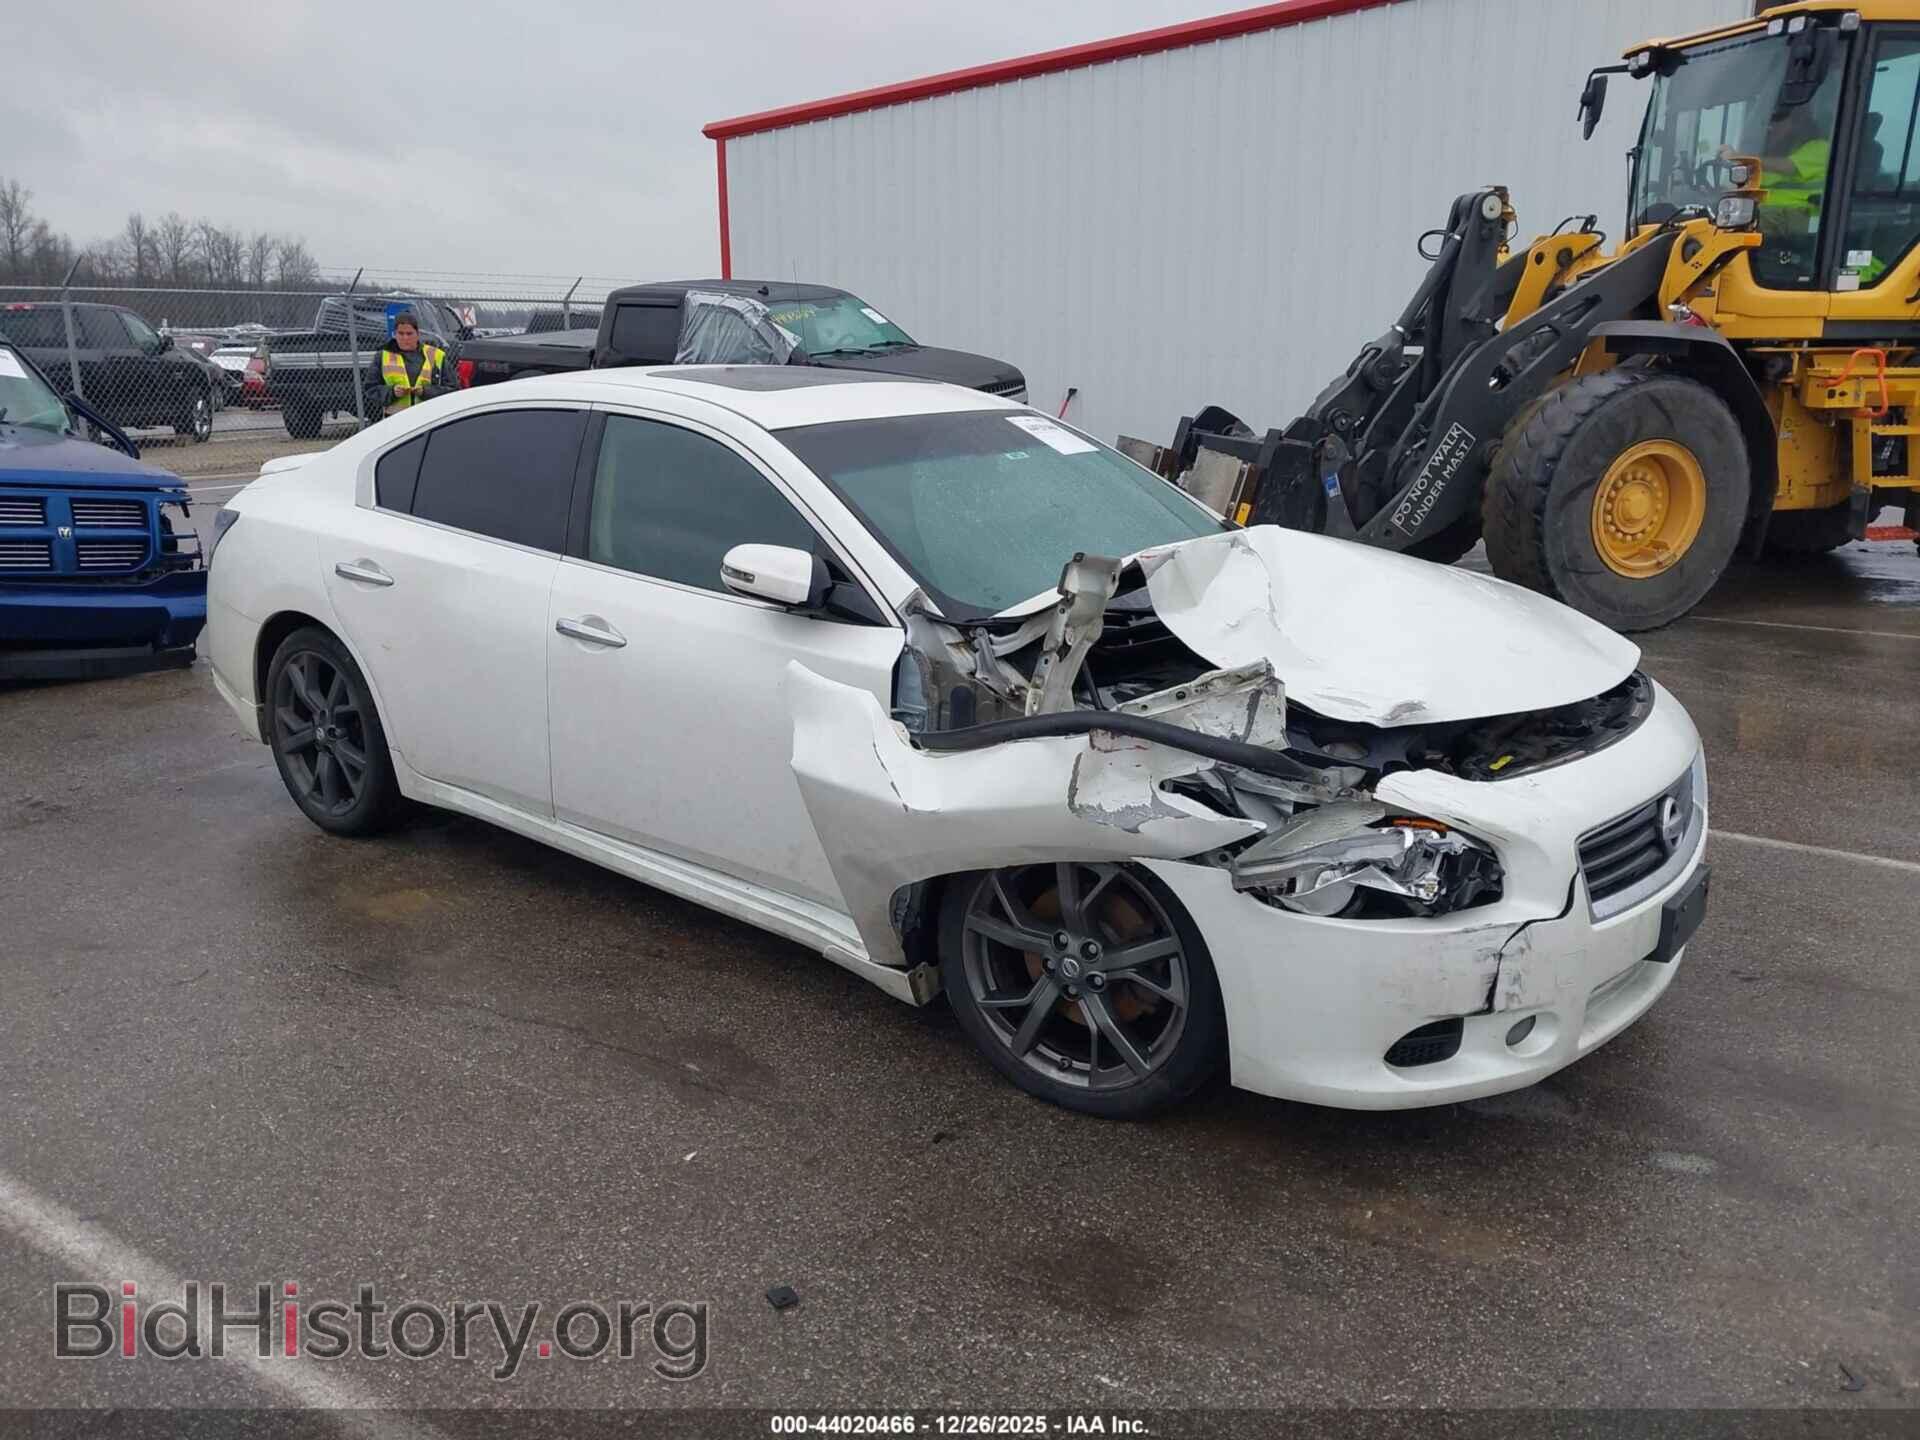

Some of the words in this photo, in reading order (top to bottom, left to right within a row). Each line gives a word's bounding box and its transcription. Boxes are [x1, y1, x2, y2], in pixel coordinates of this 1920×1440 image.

[1394, 503, 1412, 525] DO
[1409, 465, 1433, 501] NOT
[1431, 427, 1462, 466] WALK
[1410, 480, 1446, 526] UNDER
[1442, 440, 1468, 479] MAST
